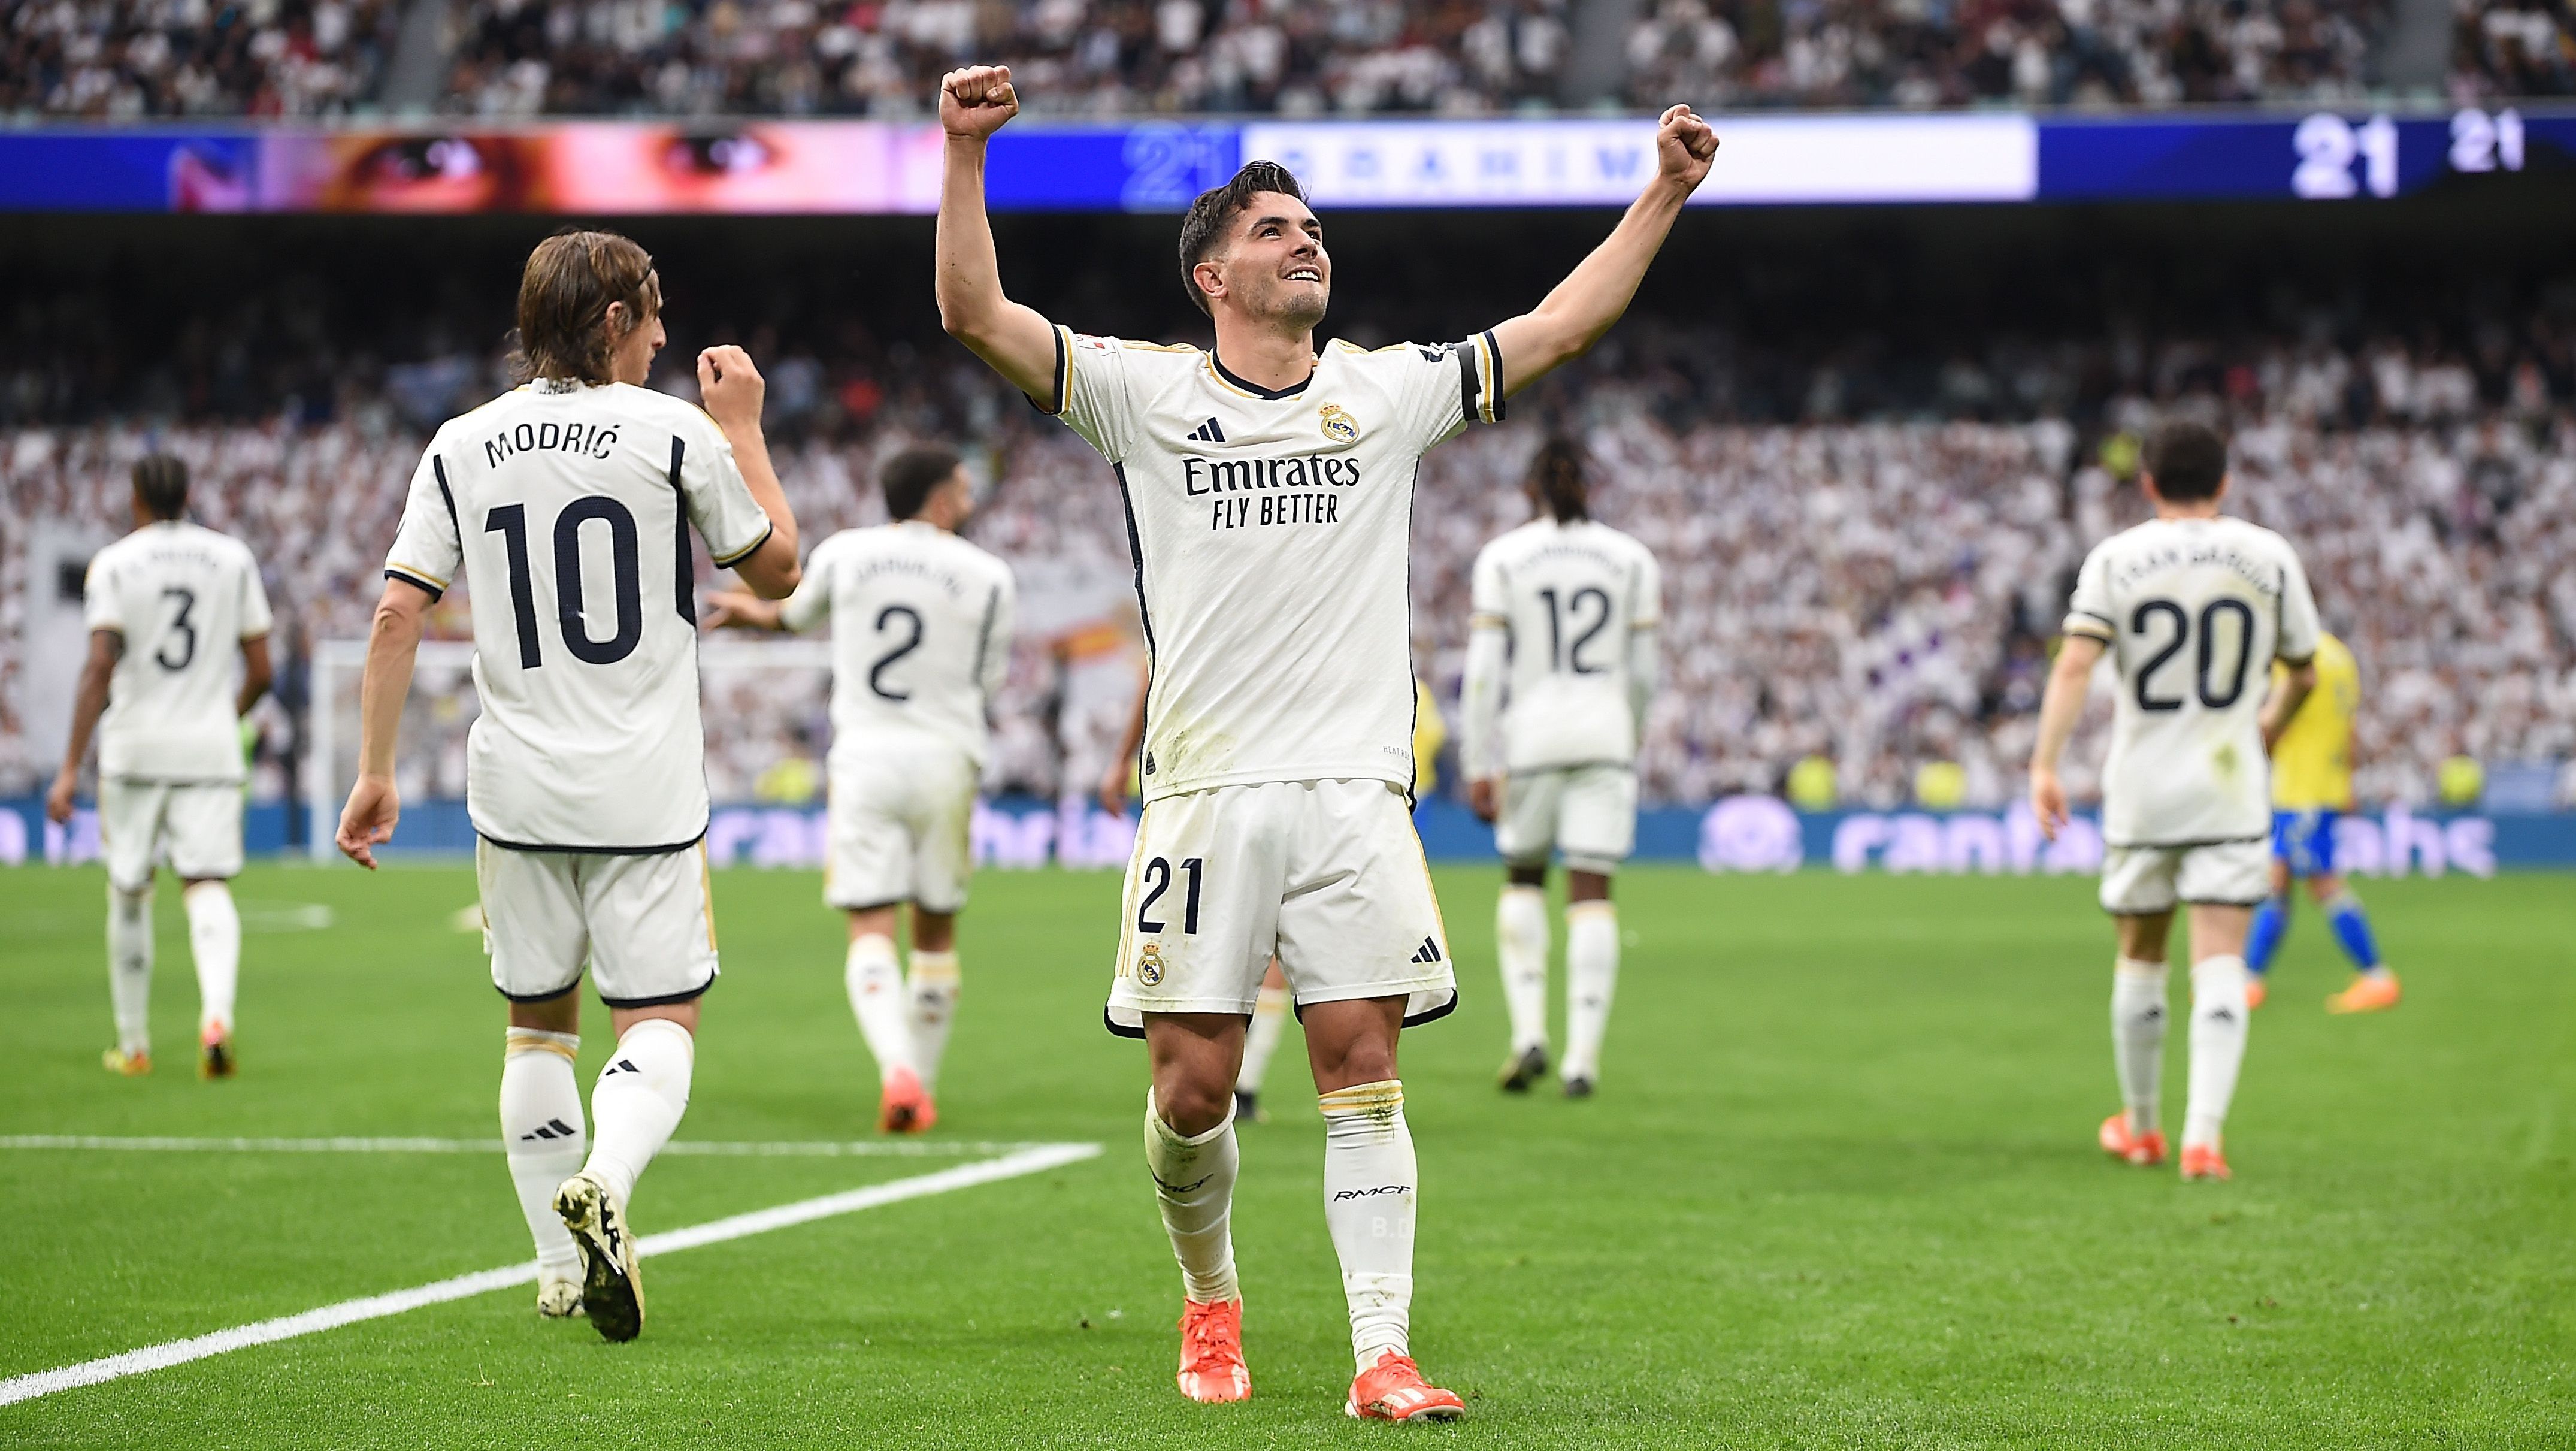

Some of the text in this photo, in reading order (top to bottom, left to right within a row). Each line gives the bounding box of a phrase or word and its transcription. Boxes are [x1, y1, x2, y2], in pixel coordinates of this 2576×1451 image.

[2290, 111, 2399, 199] 21
[2449, 107, 2525, 172] 21
[485, 423, 620, 468] MODRIĆ
[1182, 453, 1360, 496] Emirates
[1212, 494, 1338, 531] FLY BETTER
[484, 495, 642, 669] 10
[156, 588, 195, 671] 3
[870, 604, 922, 701] 2
[1539, 586, 1611, 675] 12
[2133, 599, 2253, 710] 20
[1138, 857, 1203, 935] 21
[1333, 1186, 1411, 1202] RMCF
